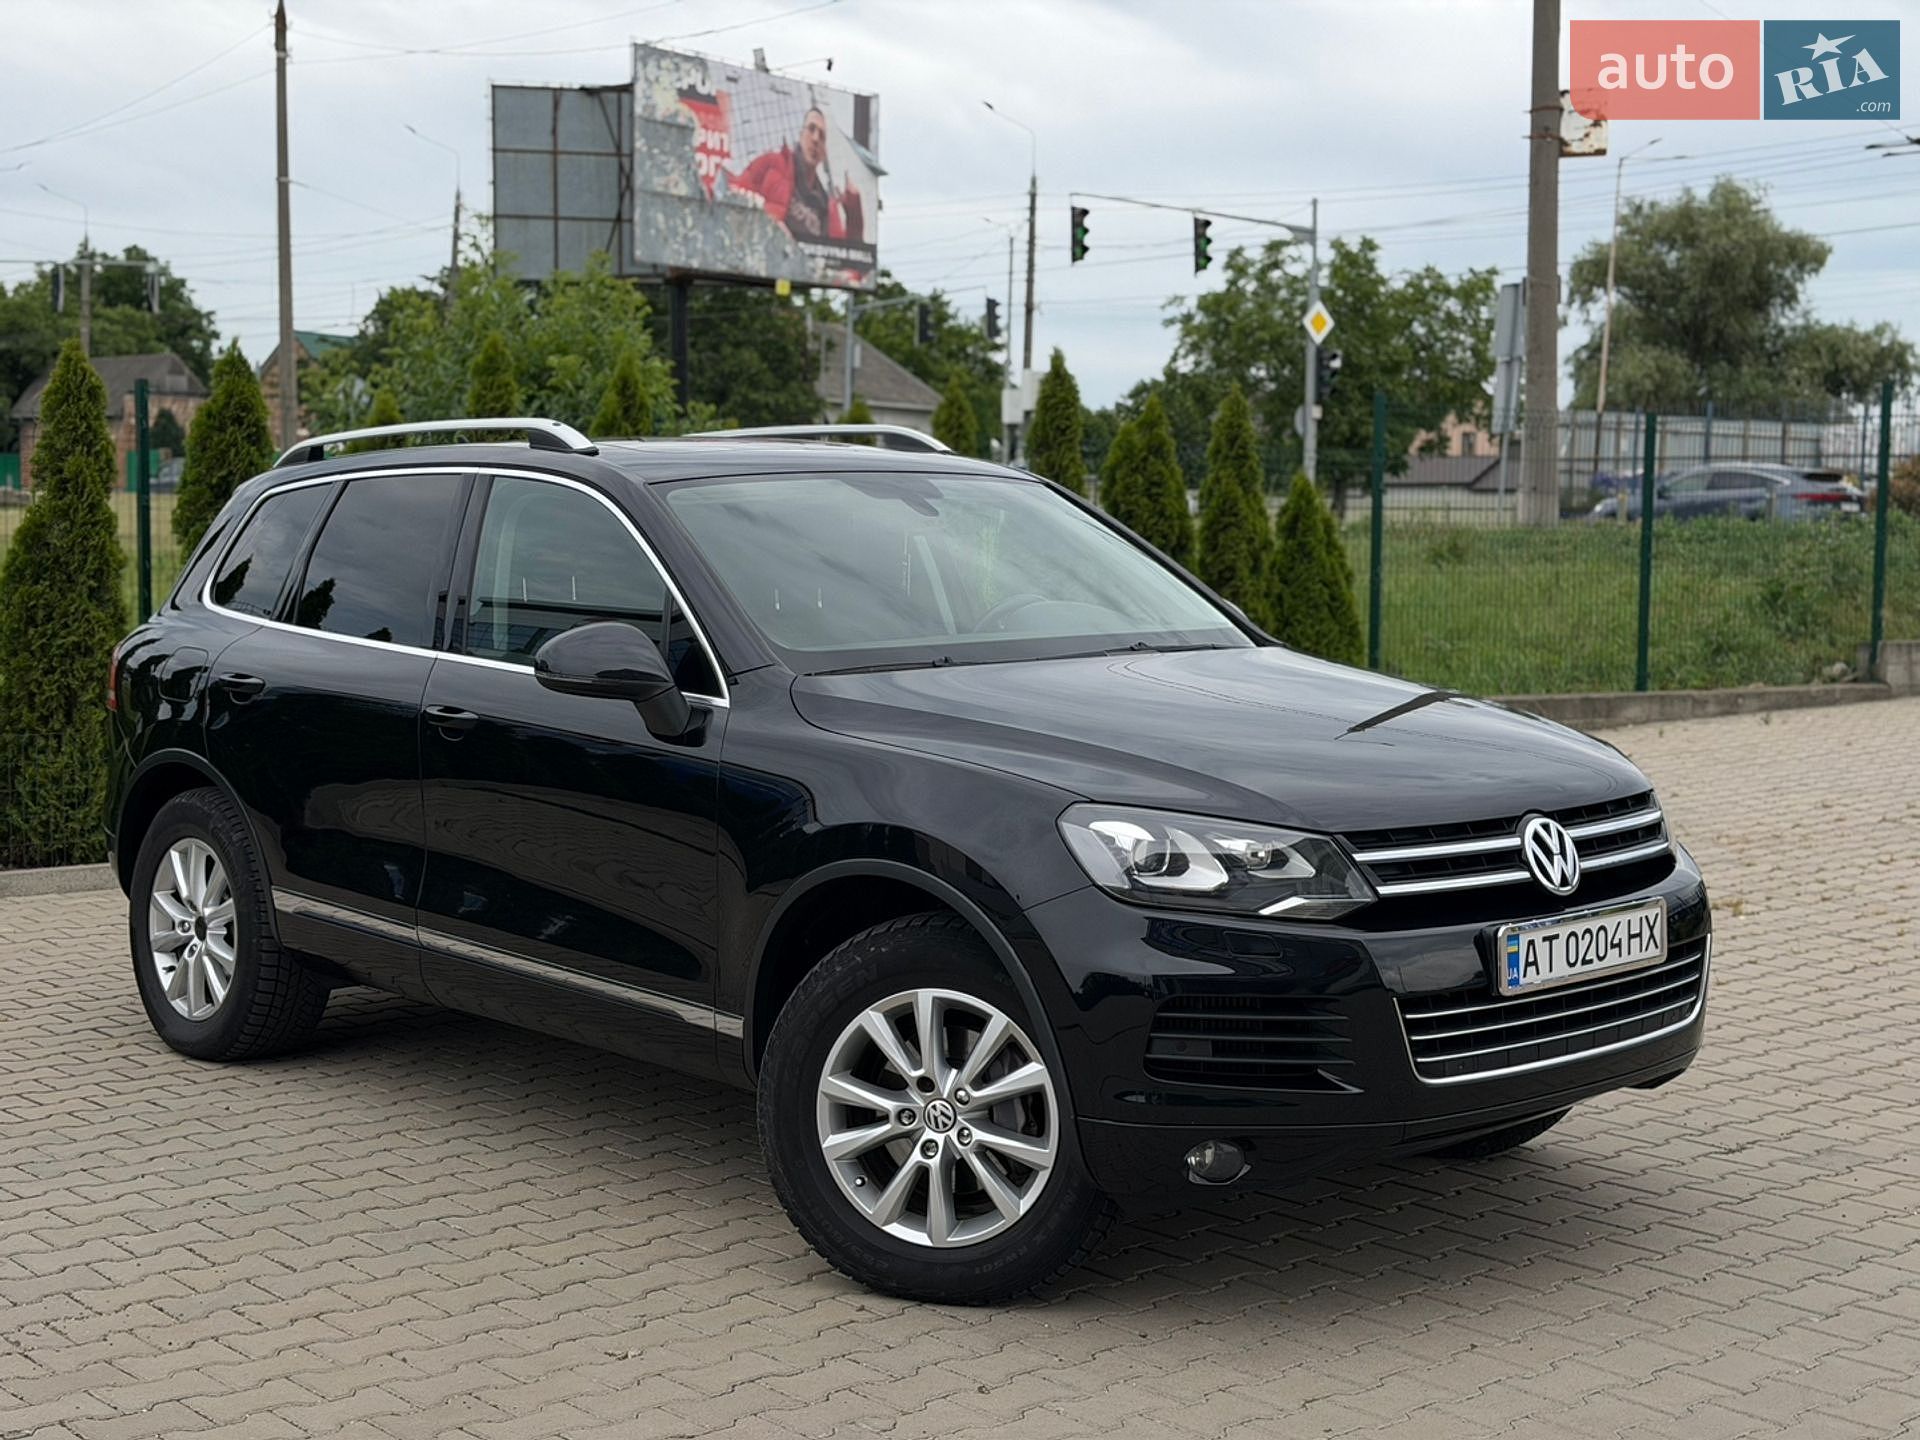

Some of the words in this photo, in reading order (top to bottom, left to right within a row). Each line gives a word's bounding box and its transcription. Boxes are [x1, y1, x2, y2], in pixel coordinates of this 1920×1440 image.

[1523, 933, 1560, 978] AT
[1565, 920, 1623, 969] 0204
[1627, 912, 1660, 956] HX
